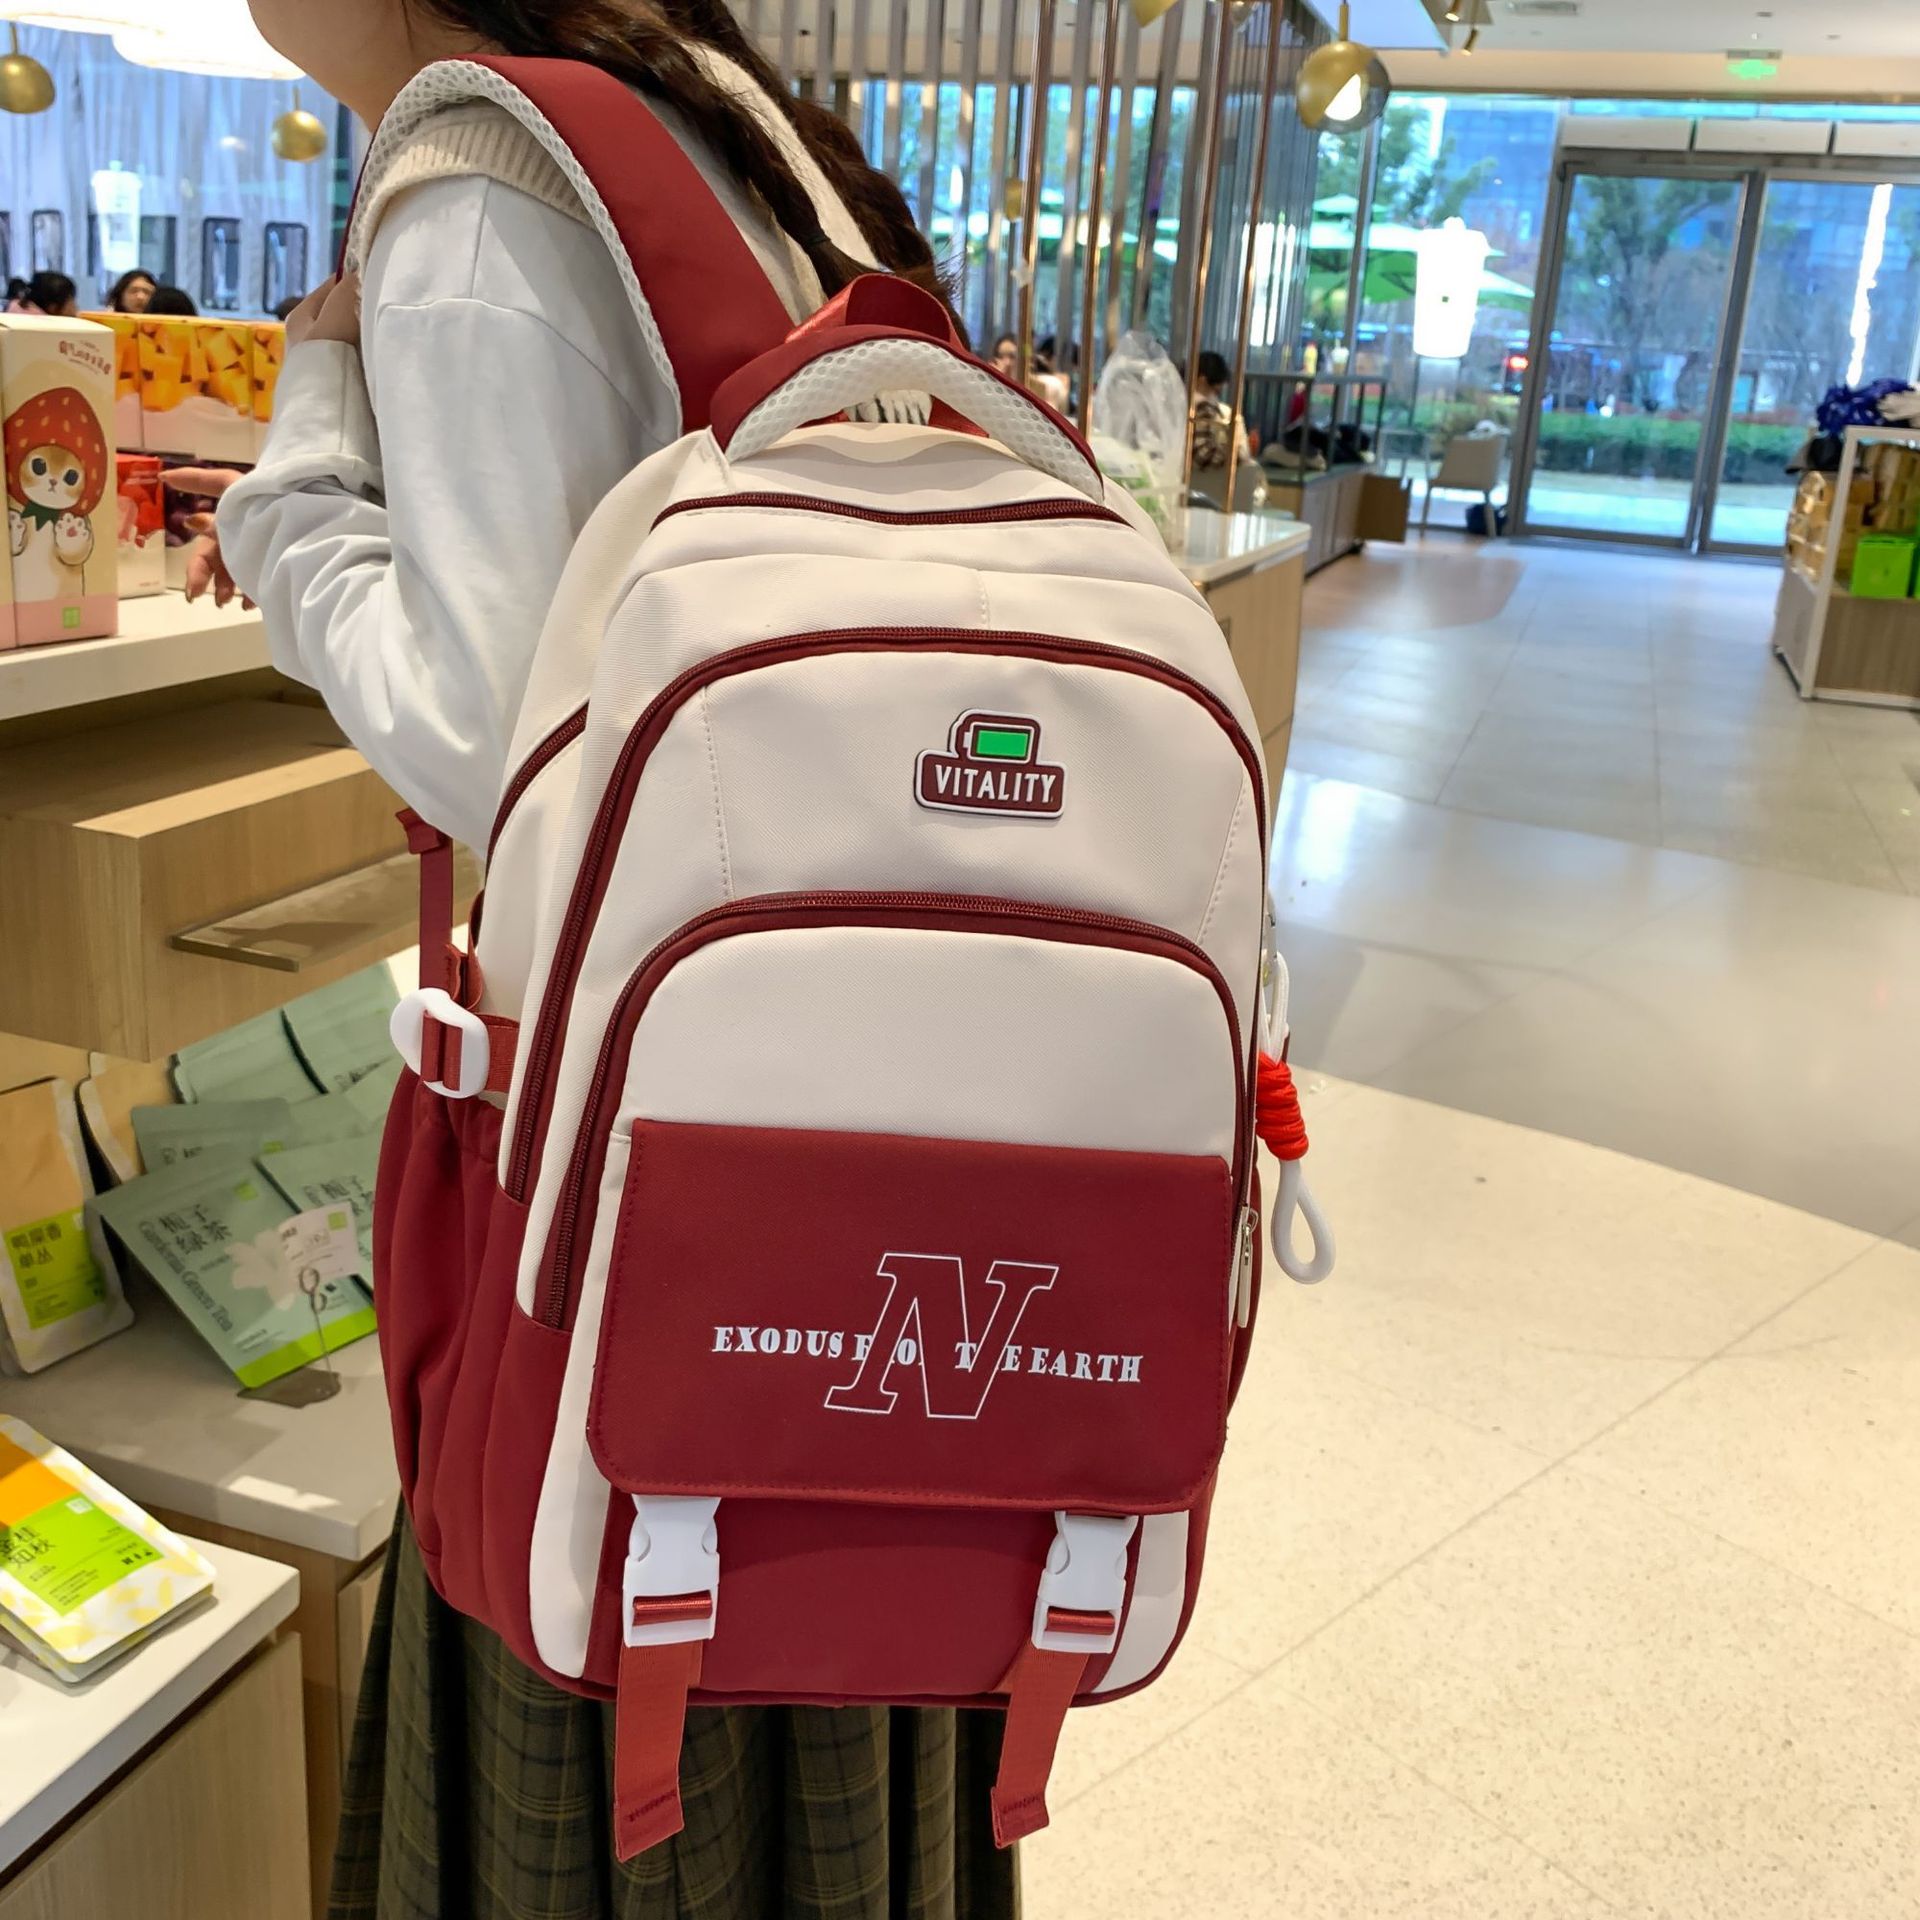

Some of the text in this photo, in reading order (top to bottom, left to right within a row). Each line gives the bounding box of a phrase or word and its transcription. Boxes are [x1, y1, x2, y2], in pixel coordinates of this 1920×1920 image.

[934, 763, 1057, 803] VITALITY
[711, 1325, 846, 1360] EXODUS
[954, 1341, 1023, 1372] TE
[1027, 1346, 1144, 1383] EARTH
[824, 1252, 1059, 1420] N
